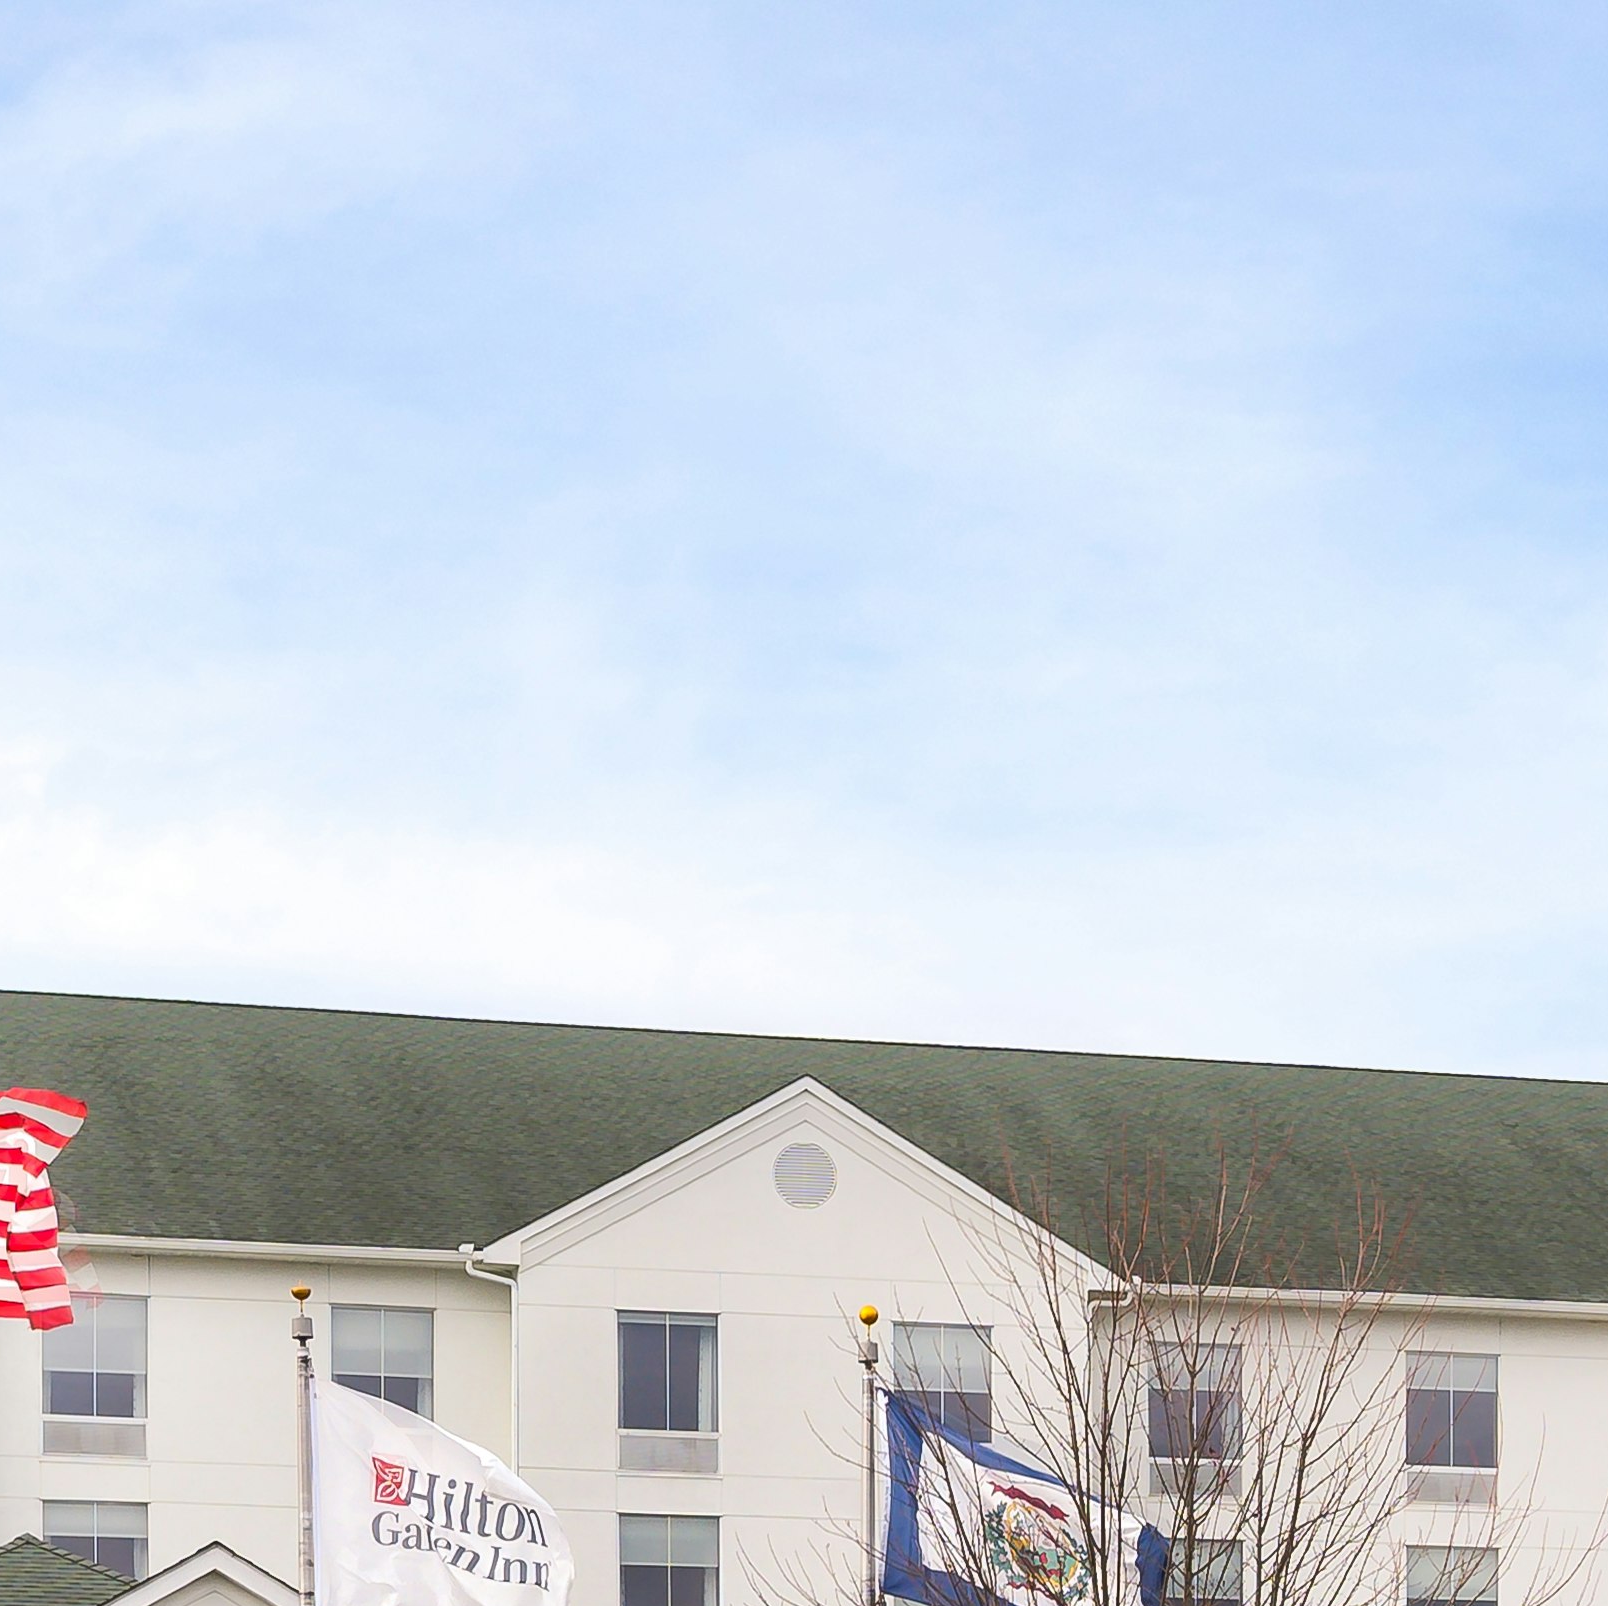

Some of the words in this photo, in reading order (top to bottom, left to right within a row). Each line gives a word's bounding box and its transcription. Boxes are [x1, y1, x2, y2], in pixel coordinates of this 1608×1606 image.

[404, 1468, 549, 1548] Hilton
[371, 1510, 476, 1575] Gaen
[482, 1545, 551, 1592] Inn
